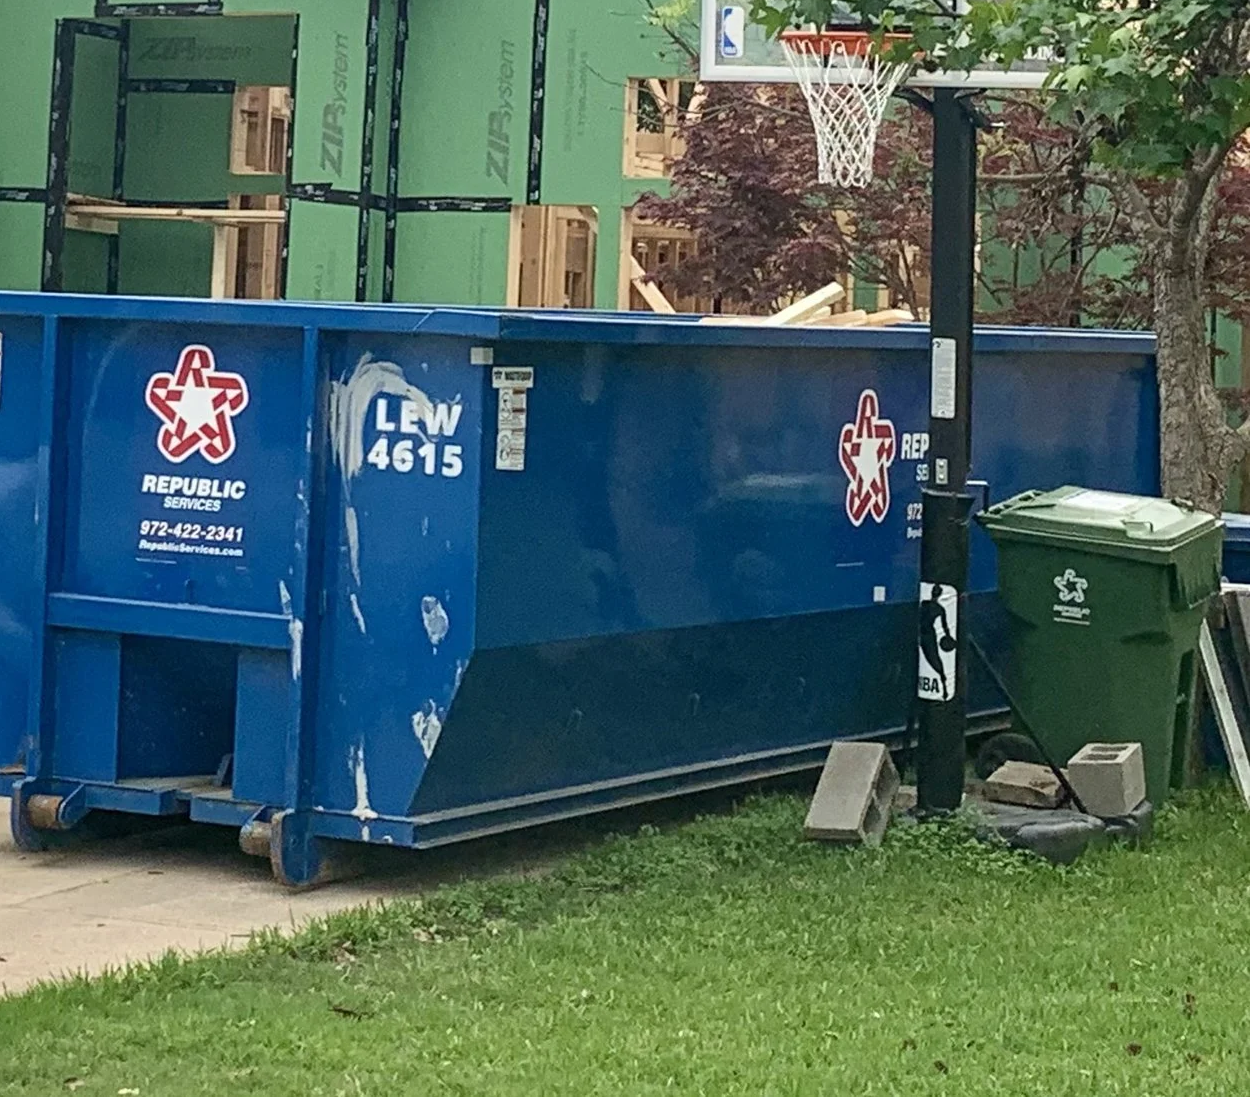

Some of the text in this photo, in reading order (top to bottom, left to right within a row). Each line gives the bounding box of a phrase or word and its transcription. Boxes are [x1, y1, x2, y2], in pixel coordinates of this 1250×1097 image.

[376, 397, 463, 437] LEW
[367, 437, 464, 478] 4615
[141, 473, 247, 500] REPUBLIC
[163, 495, 222, 512] SERVICES
[139, 520, 244, 543] 972-422-2341
[138, 538, 244, 557] RepublicServices.com
